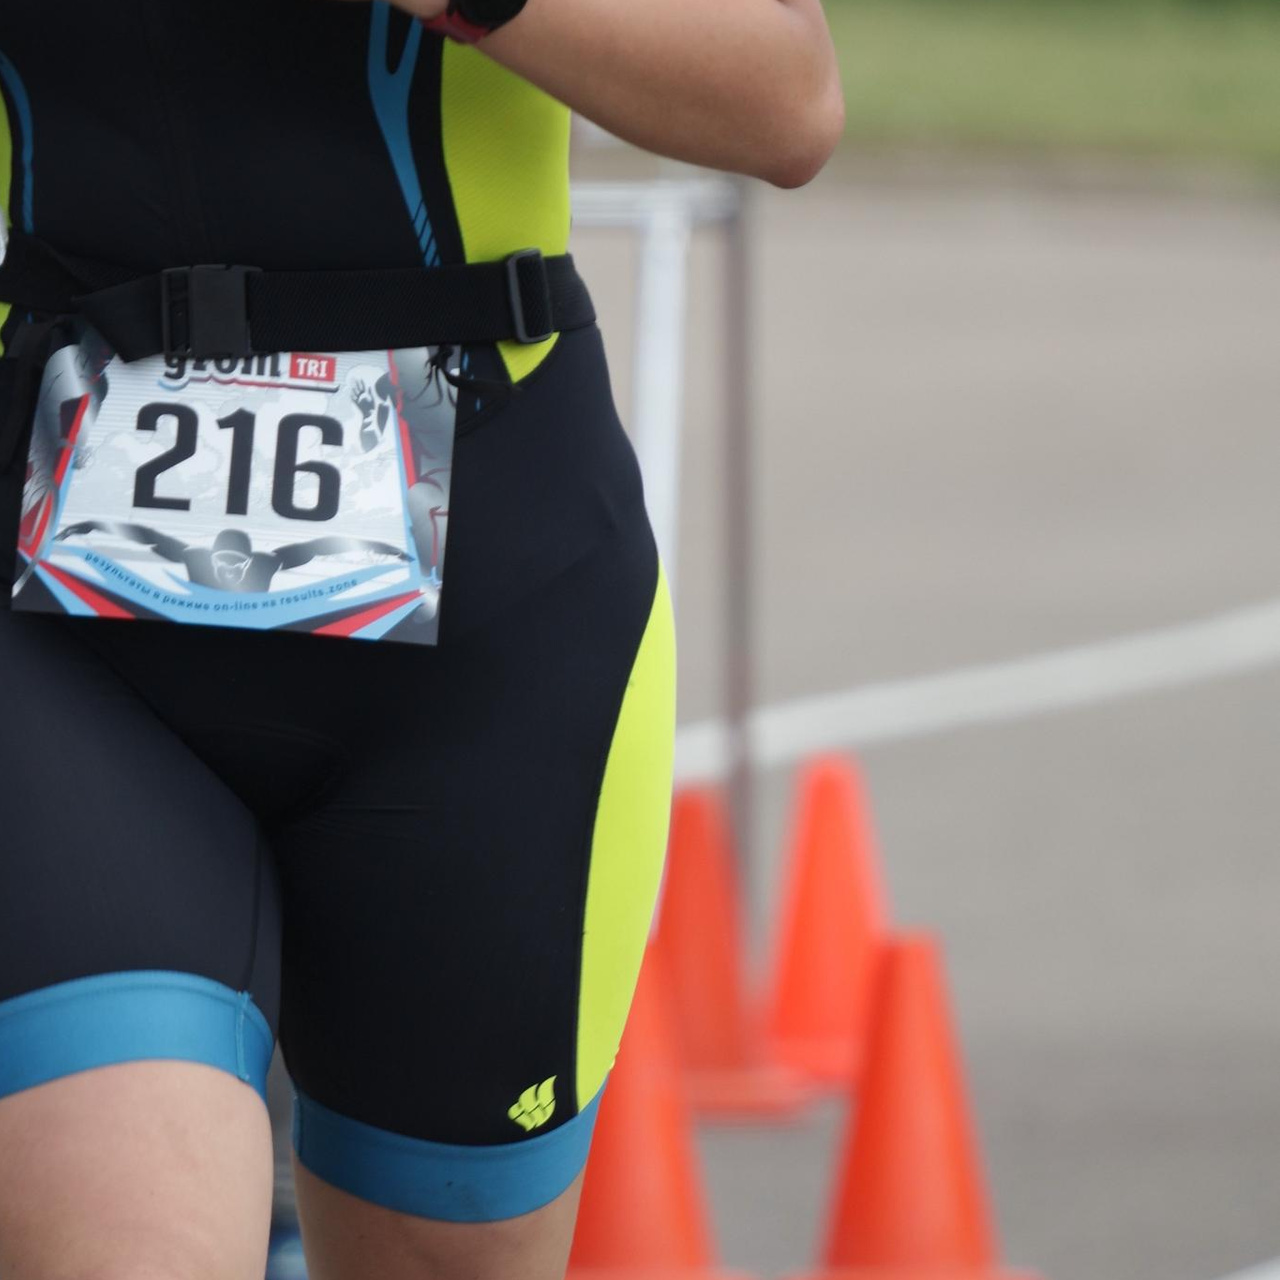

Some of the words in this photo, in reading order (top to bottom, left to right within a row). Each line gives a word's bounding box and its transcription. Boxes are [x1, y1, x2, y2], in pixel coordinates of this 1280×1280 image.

[296, 358, 328, 378] TRI
[133, 402, 344, 521] 216
[84, 552, 150, 594] результаты
[162, 594, 210, 611] режиме
[213, 600, 259, 612] on-line
